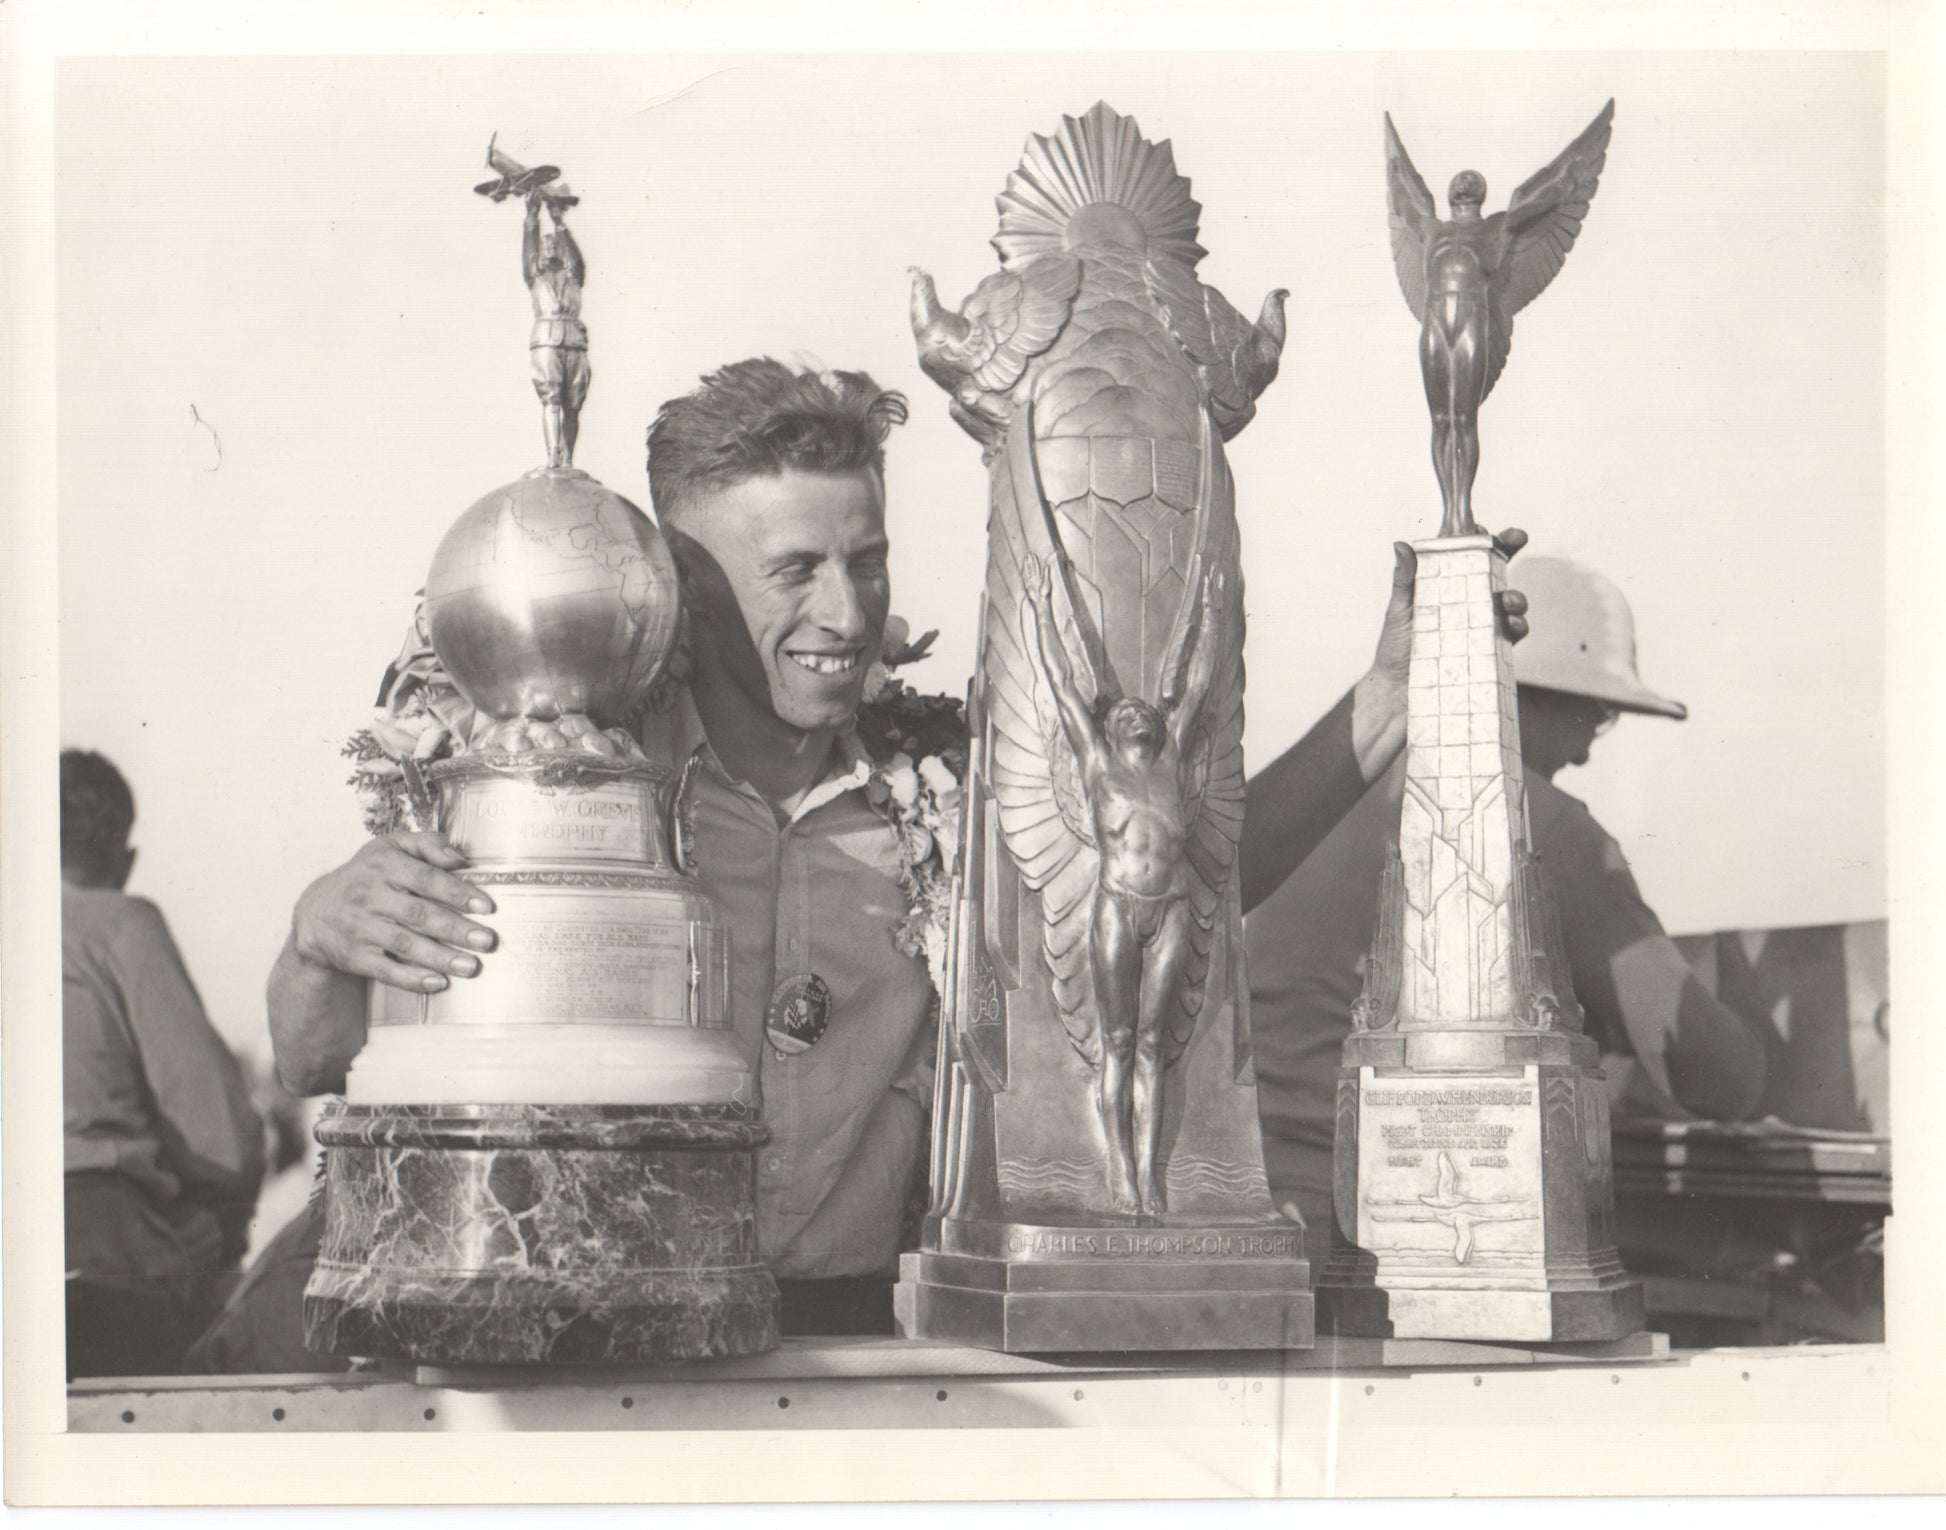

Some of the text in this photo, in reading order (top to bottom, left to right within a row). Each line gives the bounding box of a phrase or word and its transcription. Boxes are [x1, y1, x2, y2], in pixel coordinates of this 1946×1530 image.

[520, 822, 609, 841] TROPHY
[1417, 1107, 1480, 1123] TROPHY
[1007, 1233, 1098, 1255] CHARLES
[1126, 1233, 1232, 1256] THOMPSON
